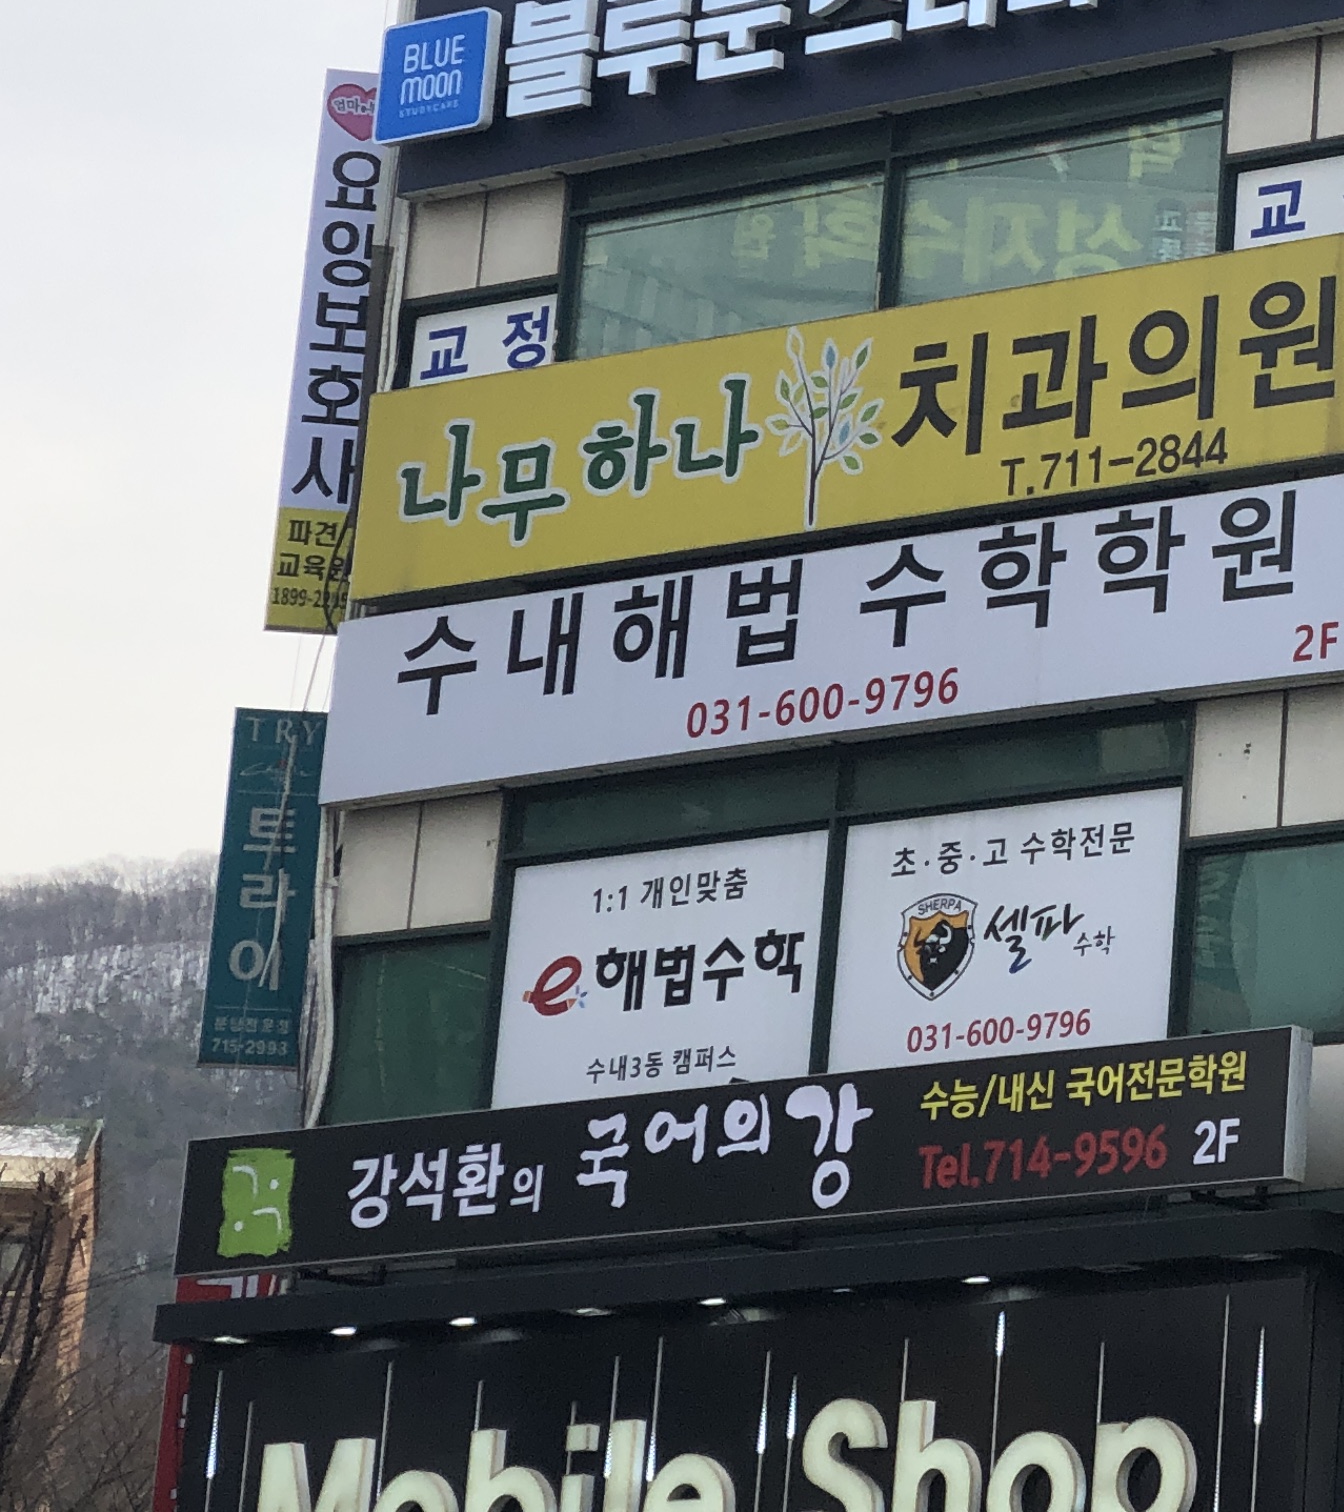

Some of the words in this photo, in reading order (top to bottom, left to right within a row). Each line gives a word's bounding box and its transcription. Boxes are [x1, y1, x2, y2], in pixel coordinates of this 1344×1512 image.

[403, 34, 465, 74] BLUE
[890, 273, 1339, 458] 치과의원
[1001, 426, 1229, 498] T.711-2844
[287, 520, 338, 548] 파견
[397, 555, 804, 716] 수내해법
[859, 489, 1297, 648] 수학학원
[1291, 621, 1340, 664] 2F
[686, 667, 960, 740] 031-600-9796
[1020, 820, 1137, 867] 수학전문
[592, 886, 629, 915] 1:1
[639, 867, 749, 908] 개인맞춤
[917, 897, 963, 918] SHERPA
[984, 903, 1085, 975] 셀파
[1072, 926, 1116, 958] 수학
[586, 1050, 665, 1082] 수내3동
[671, 1044, 737, 1077] 캠퍼스
[906, 1007, 1093, 1055] 031-600-9796
[920, 1070, 1056, 1123] 수능/내신
[1065, 1049, 1248, 1109] 국어전문학원
[346, 1141, 545, 1229] 강석환의
[919, 1123, 1169, 1189] Tel.714-9596
[1193, 1117, 1241, 1167] 2F
[803, 1397, 1197, 1512] Shop
